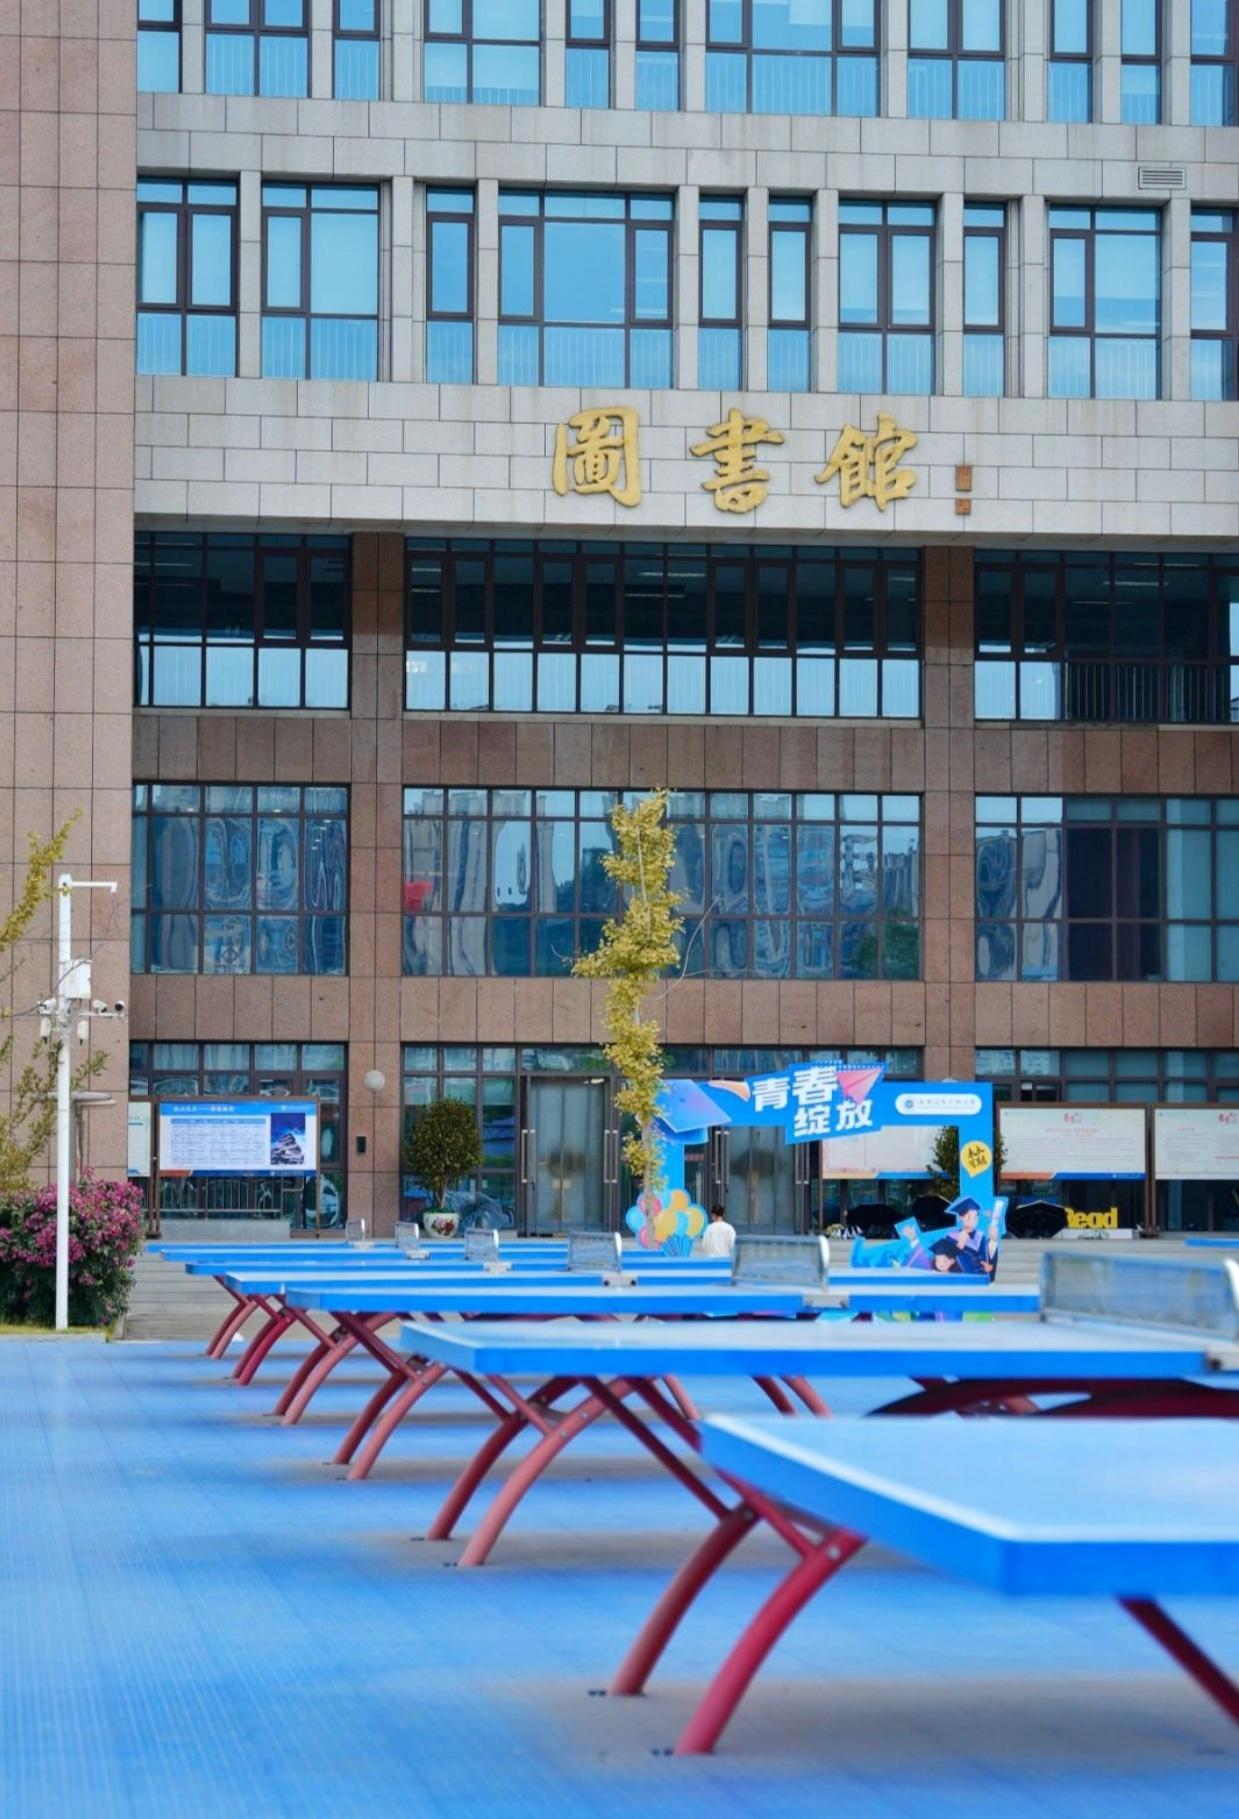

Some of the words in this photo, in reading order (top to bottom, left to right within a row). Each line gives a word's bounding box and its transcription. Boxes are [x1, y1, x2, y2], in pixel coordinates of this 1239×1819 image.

[552, 406, 918, 513] 圖書館
[753, 1066, 838, 1112] 青春
[794, 1099, 873, 1137] 绽放
